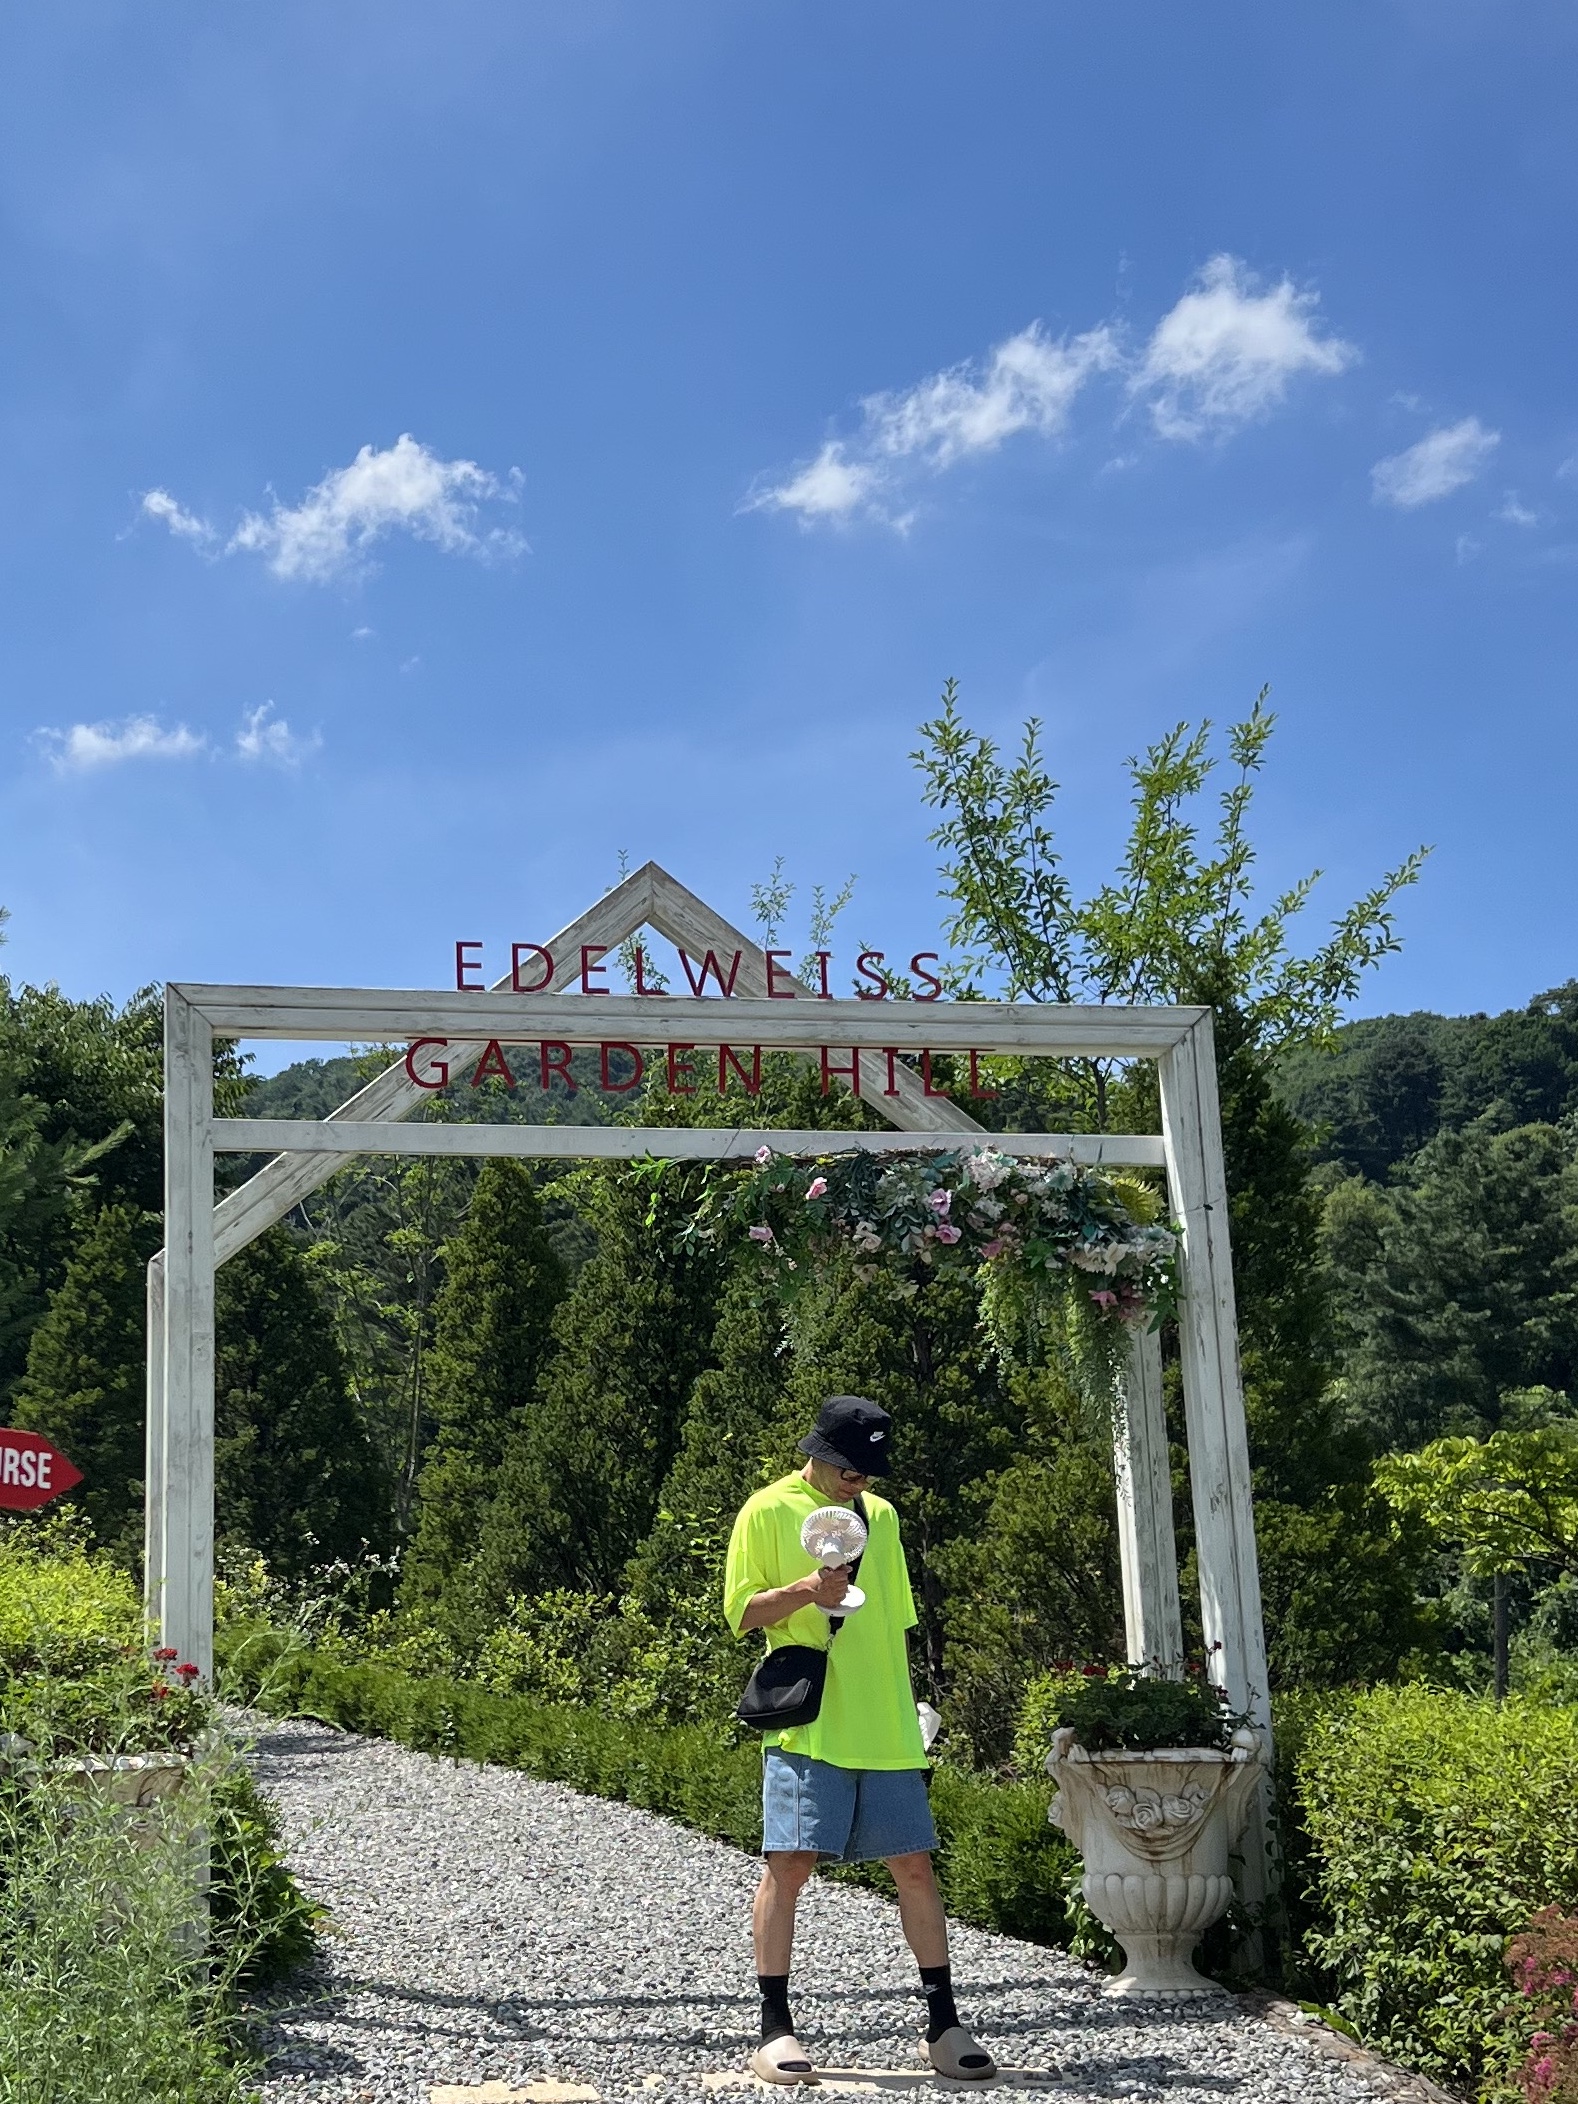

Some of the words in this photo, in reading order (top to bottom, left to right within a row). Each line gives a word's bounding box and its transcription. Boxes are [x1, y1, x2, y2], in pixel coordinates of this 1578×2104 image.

[456, 942, 943, 1001] EDELWEISS
[406, 1038, 761, 1095] GARDEN
[821, 1047, 996, 1098] HILL
[0, 1447, 52, 1489] RSE
